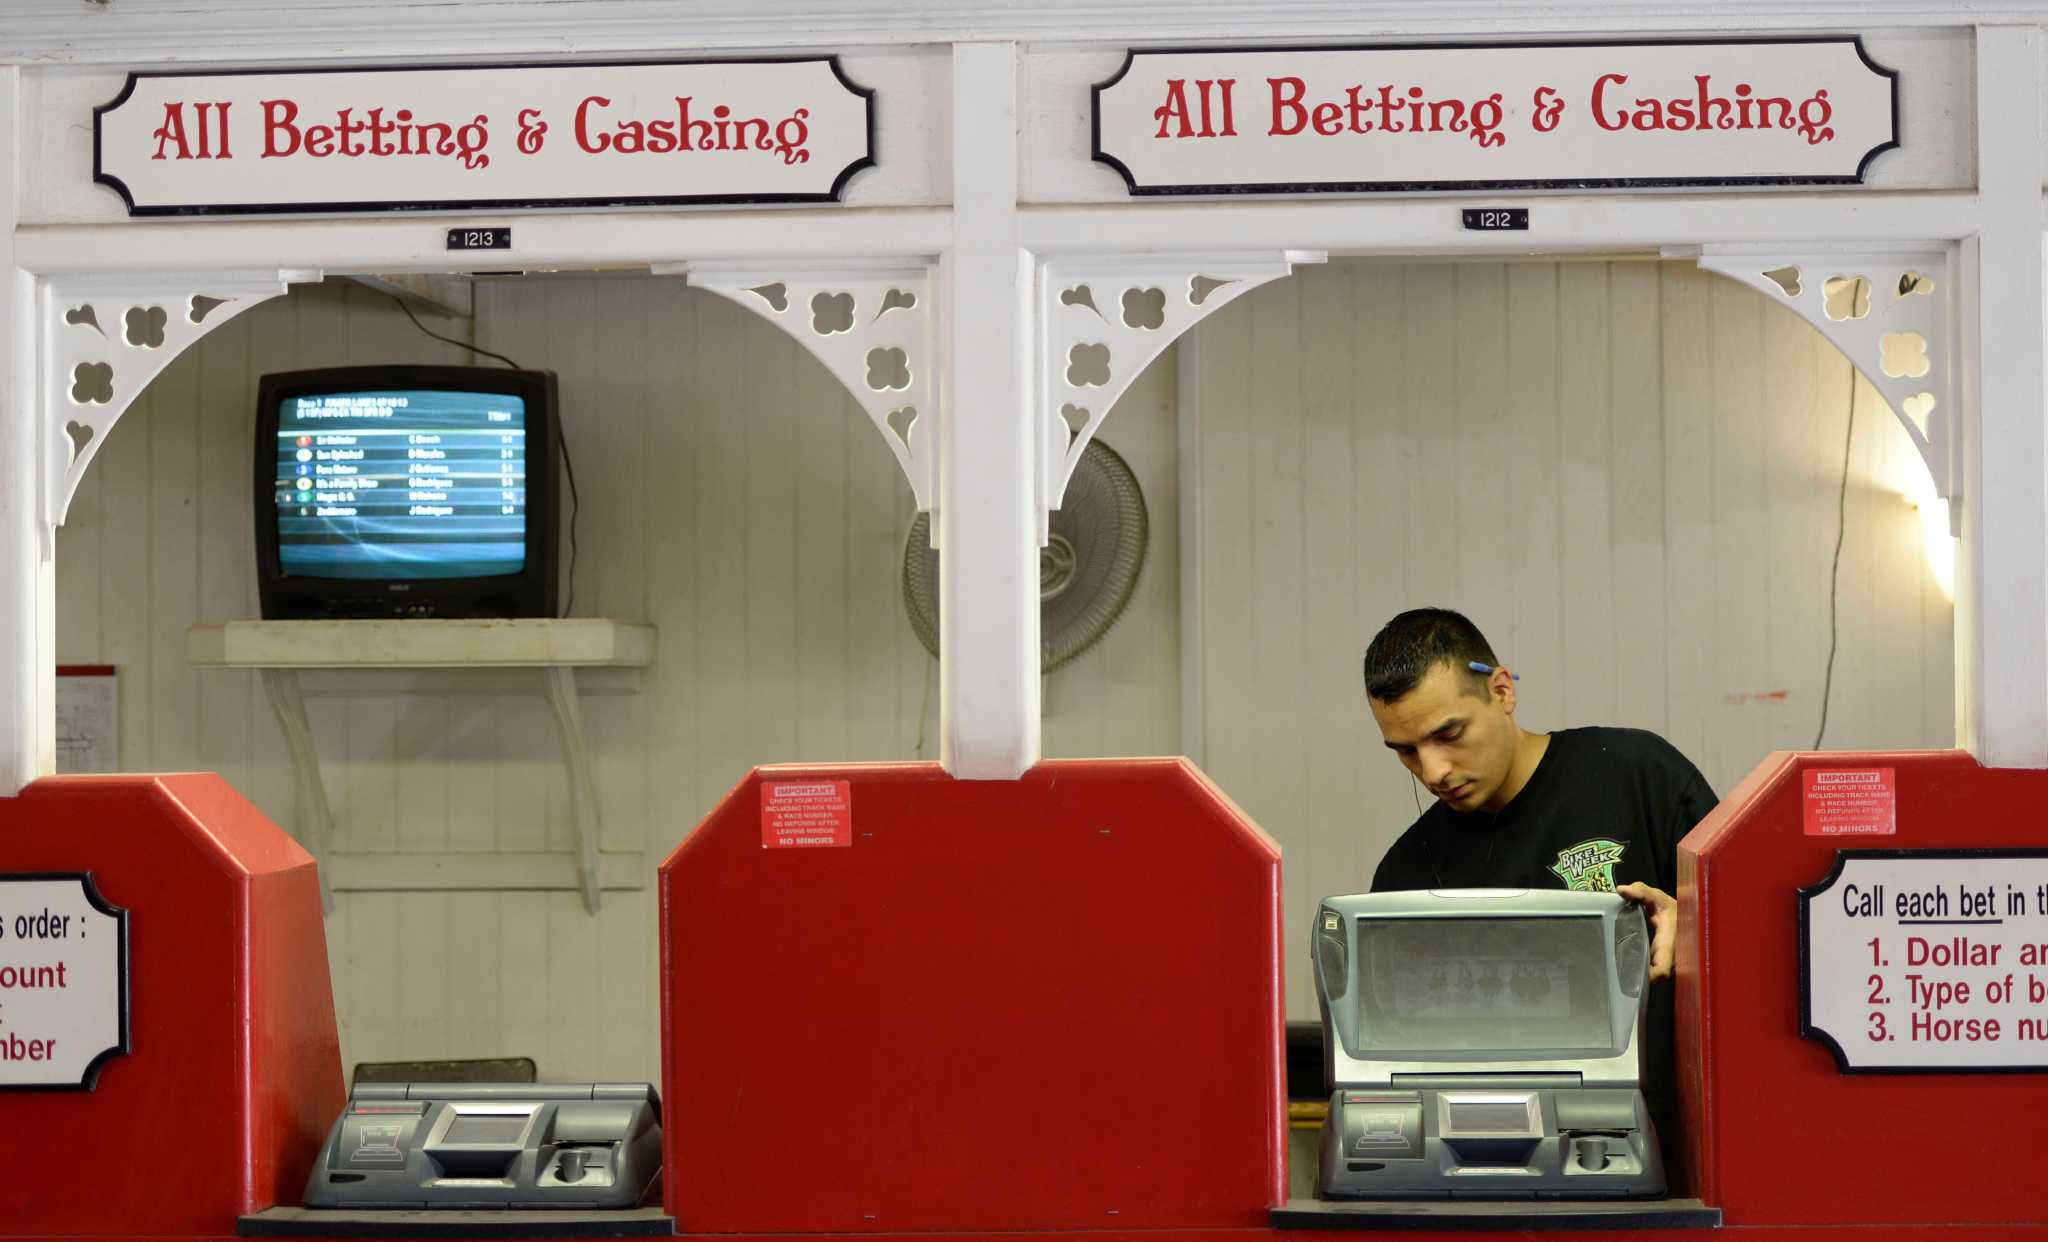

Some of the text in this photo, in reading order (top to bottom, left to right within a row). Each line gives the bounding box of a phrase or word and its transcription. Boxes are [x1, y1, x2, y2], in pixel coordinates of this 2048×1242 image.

[1153, 72, 1835, 149] All Betting & Cashing
[152, 95, 810, 171] All Betting & Cashing
[1480, 212, 1511, 227] 1212
[465, 231, 493, 247] 1213
[777, 786, 832, 795] IMPORTANT
[1820, 774, 1877, 782] IMPORTANT
[779, 836, 834, 846] NO MINORS
[1822, 824, 1878, 833] NO MINORS
[1562, 847, 1594, 869] BIKE
[1570, 852, 1610, 877] WEEK
[1843, 884, 1884, 917] Call
[1896, 884, 1949, 918] each
[1960, 884, 1996, 917] bet
[2007, 884, 2026, 916] in
[15, 907, 70, 939] order
[1867, 937, 1889, 967] 1.
[1907, 936, 2002, 967] Dollar
[1867, 973, 1891, 1005] 2.
[1905, 974, 1970, 1010] Type
[1985, 973, 2013, 1004] of
[1867, 1011, 1895, 1042] 3.
[1911, 1012, 2001, 1042] Horse
